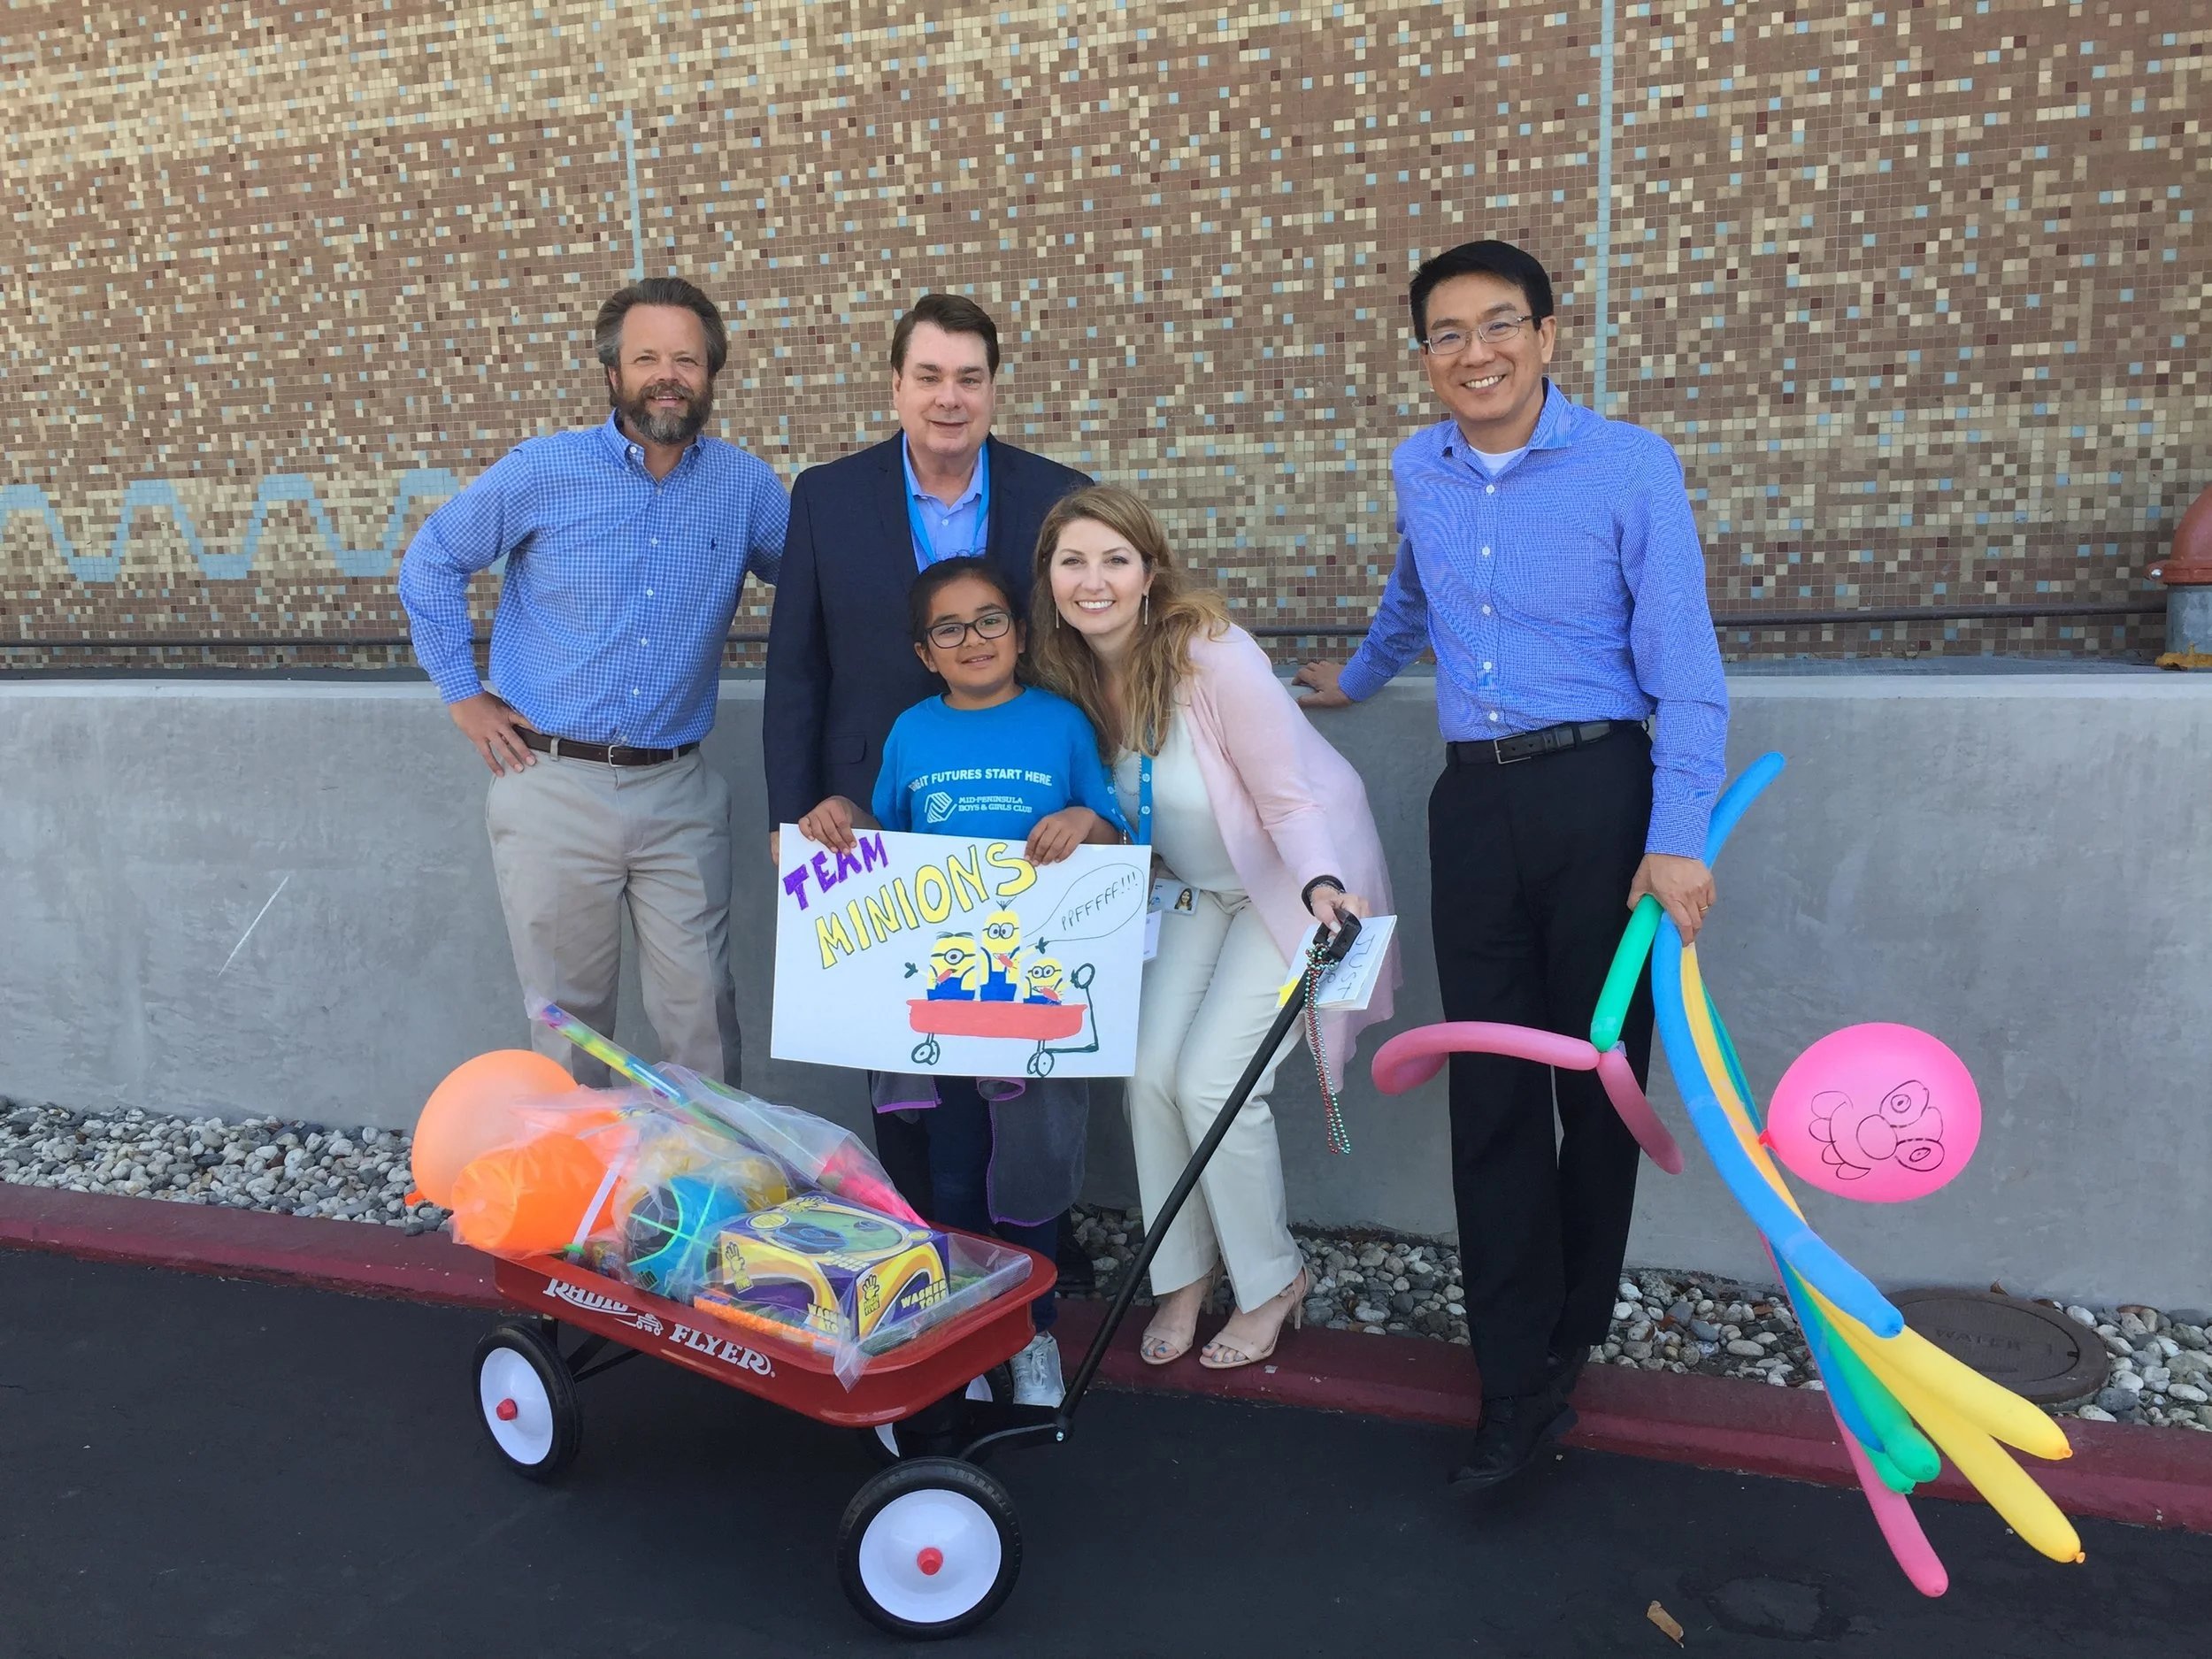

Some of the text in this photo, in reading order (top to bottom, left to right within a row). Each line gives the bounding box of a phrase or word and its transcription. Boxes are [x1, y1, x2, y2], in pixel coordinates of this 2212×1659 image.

[931, 769, 982, 784] FUTURES
[985, 768, 1022, 780] START
[958, 795, 1023, 805] MID-PENINSULA
[1013, 804, 1033, 813] CLUB
[782, 832, 888, 910] TEAM
[815, 842, 1037, 969] MINIONS
[1337, 926, 1376, 999] JUST
[900, 1279, 948, 1308] WASHER
[669, 1323, 772, 1377] FLYER
[1935, 1328, 2021, 1351] WATER
